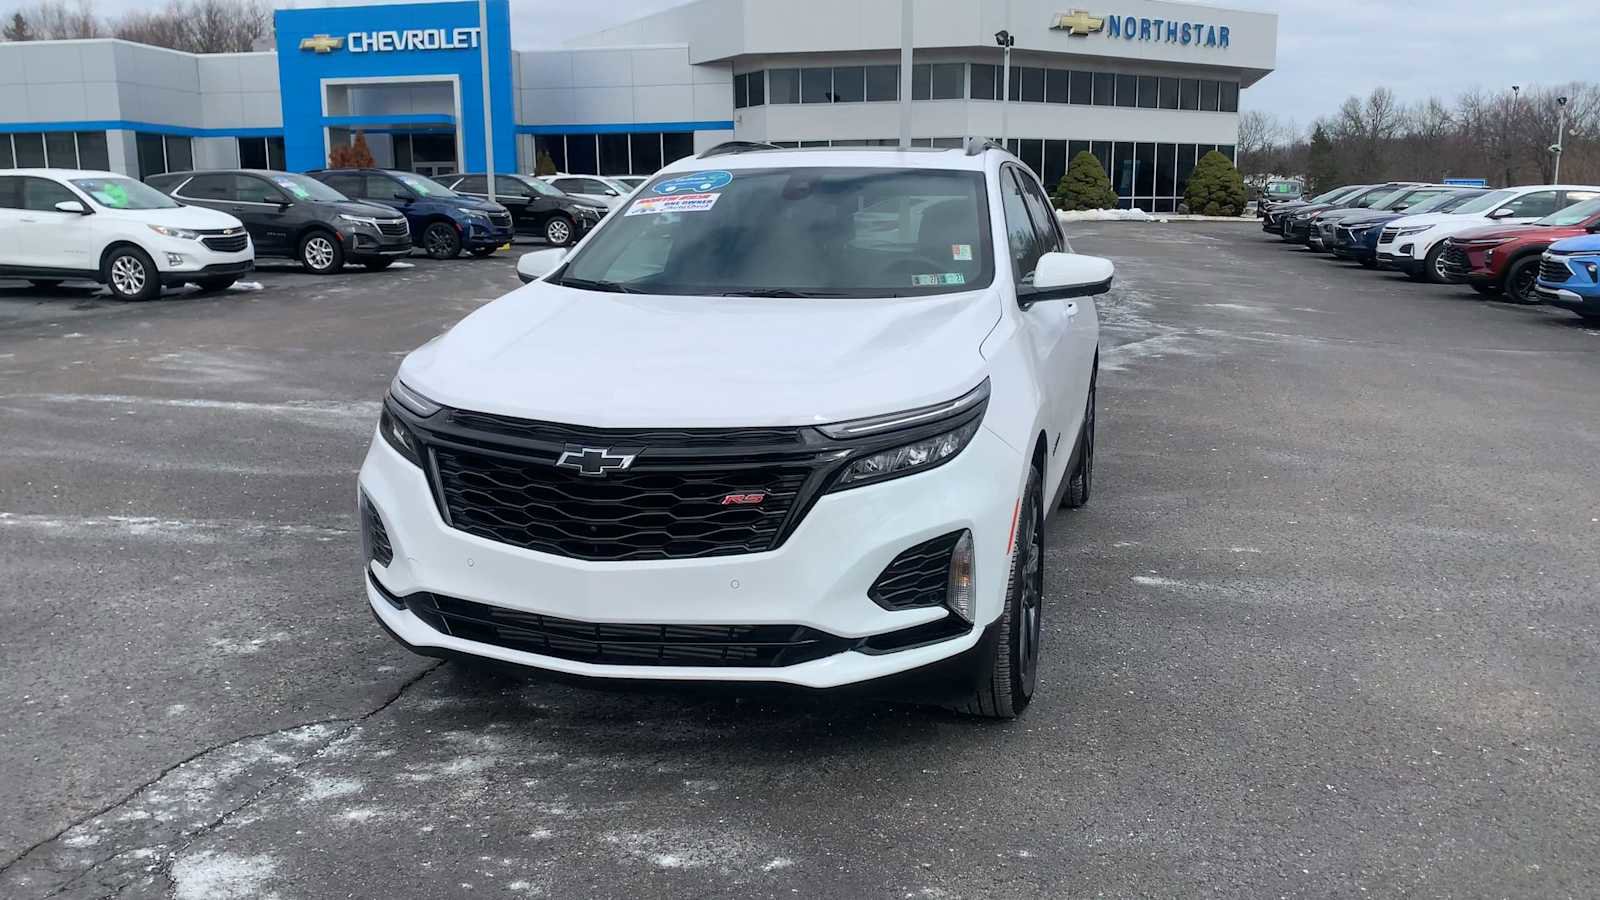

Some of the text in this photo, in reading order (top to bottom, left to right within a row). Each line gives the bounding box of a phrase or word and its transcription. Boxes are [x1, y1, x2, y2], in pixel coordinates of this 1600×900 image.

[347, 27, 480, 52] CHEVROLET
[1107, 15, 1230, 48] NORTHSTAR
[721, 494, 765, 505] RS
